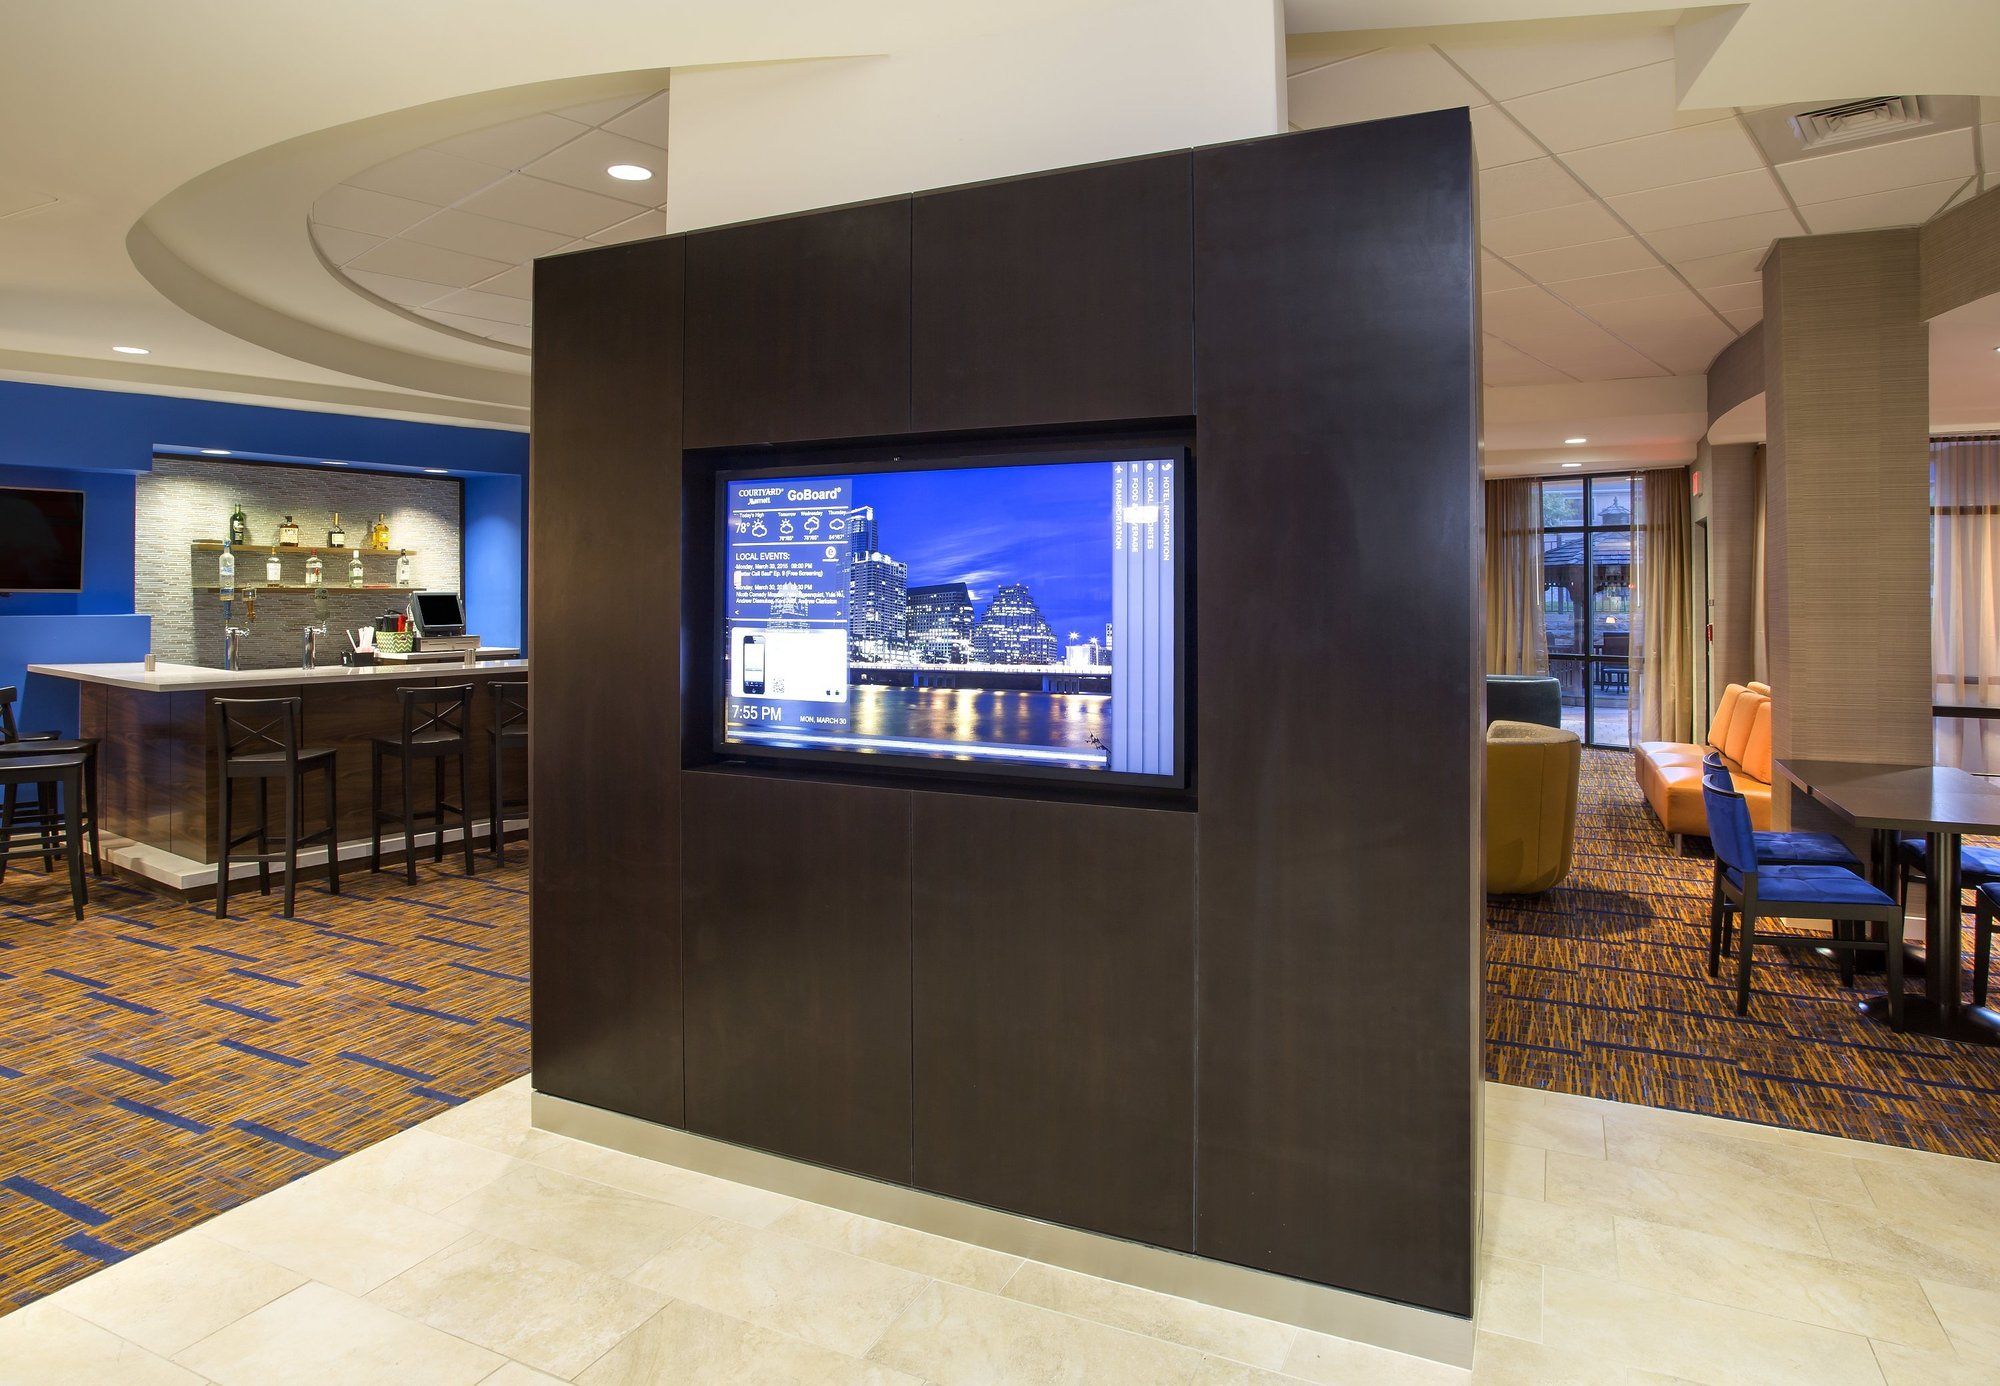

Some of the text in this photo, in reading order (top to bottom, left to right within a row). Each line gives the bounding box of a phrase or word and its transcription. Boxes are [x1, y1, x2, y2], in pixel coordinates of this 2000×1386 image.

[739, 488, 781, 497] COURTYARD
[760, 552, 790, 560] EVENTS:
[732, 705, 782, 721] 7:55 PM
[800, 715, 815, 723] MON,
[816, 716, 839, 724] MARCH
